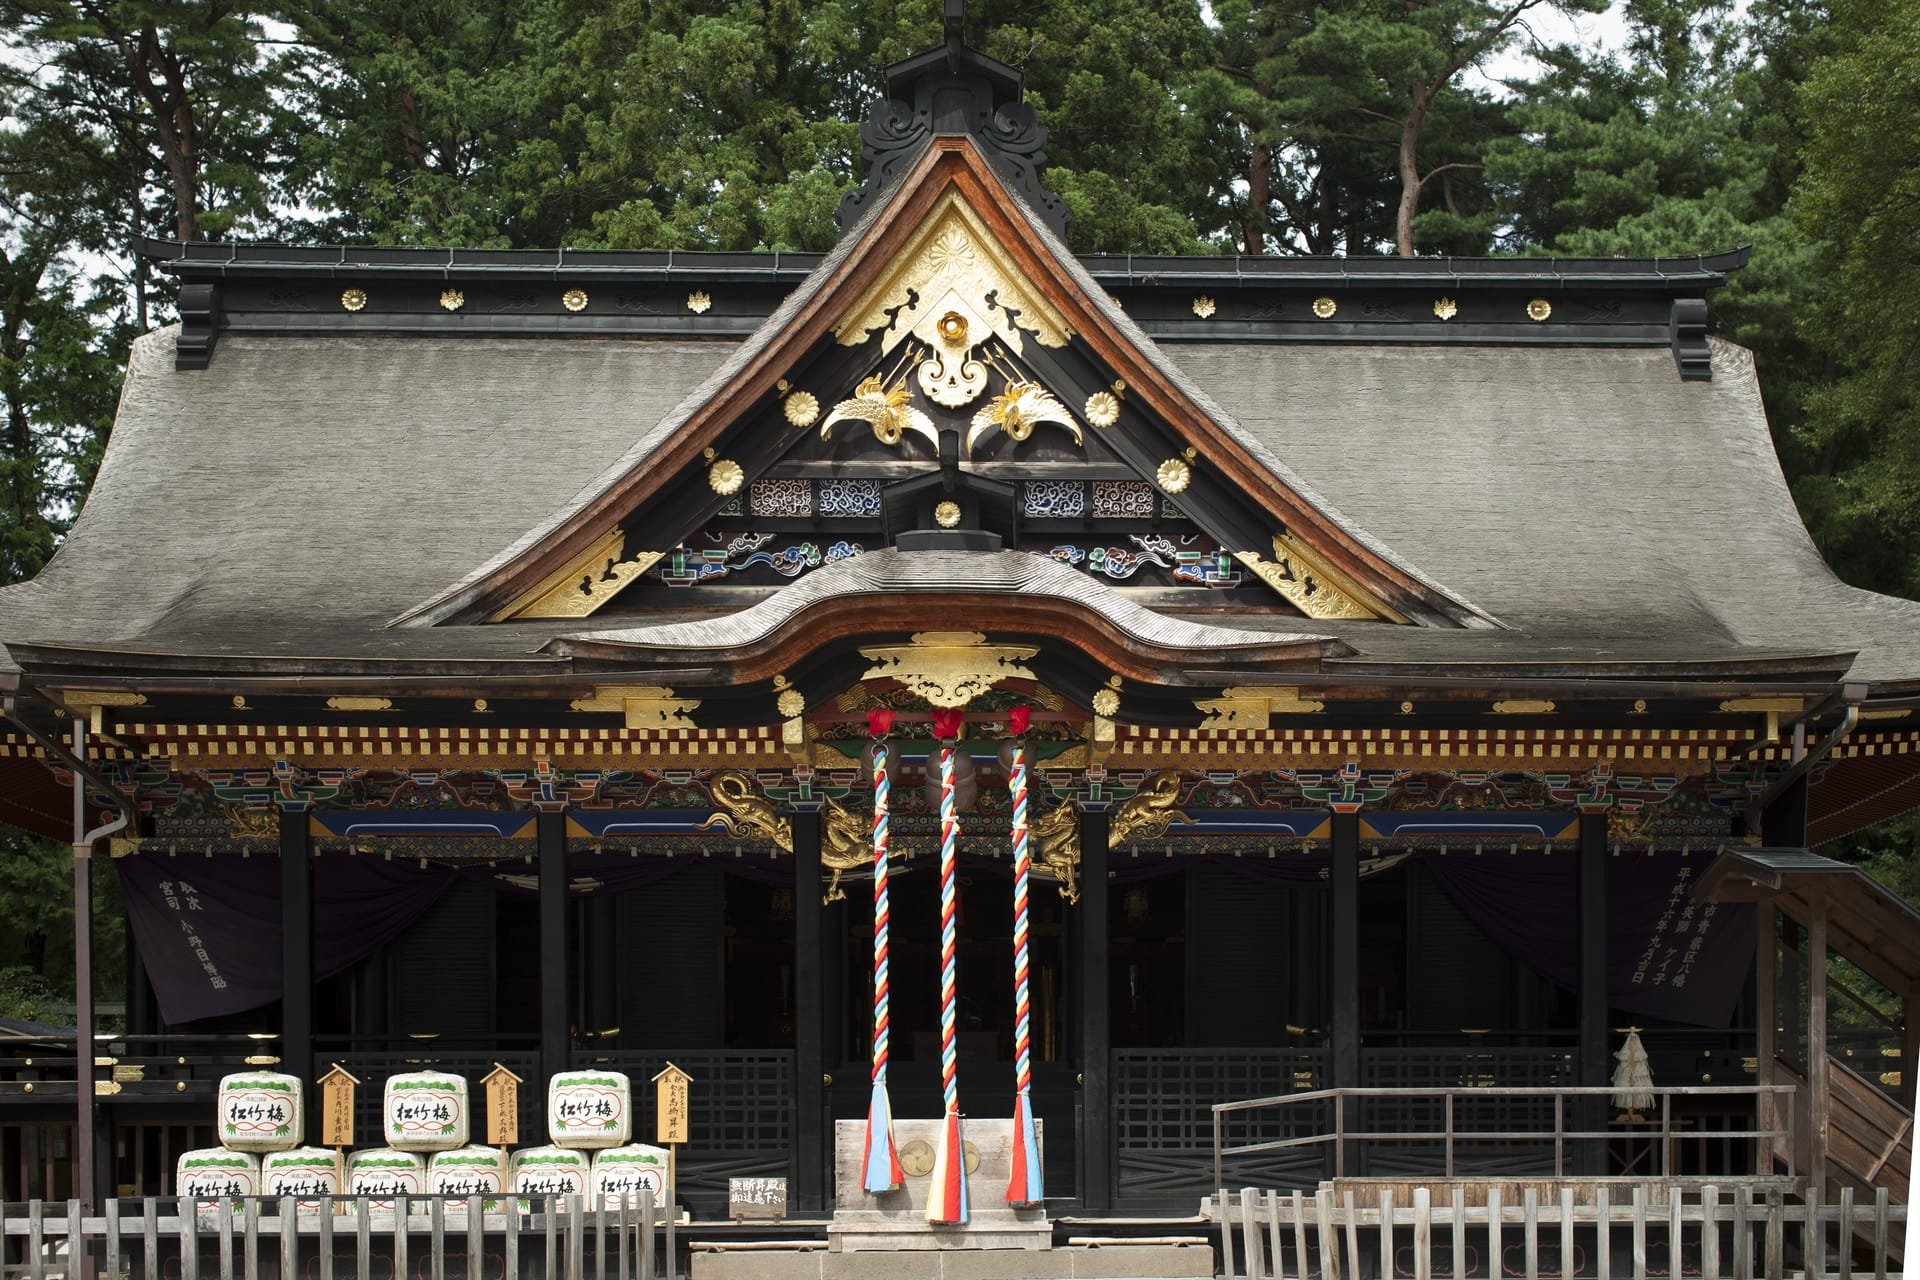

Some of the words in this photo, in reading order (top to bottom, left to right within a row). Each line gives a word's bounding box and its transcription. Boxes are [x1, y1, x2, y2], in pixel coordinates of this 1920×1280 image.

[159, 880, 181, 911] 宮司
[178, 880, 205, 911] 取次
[1652, 947, 1678, 986] ケイ子
[230, 1102, 286, 1122] 松竹梅
[397, 1102, 451, 1121] 松竹梅
[560, 1099, 613, 1118] 松竹梅
[188, 1179, 243, 1196] 松竹梅
[275, 1179, 331, 1196] 松竹梅
[356, 1179, 408, 1196] 松竹梅
[437, 1178, 493, 1195] 松竹梅
[522, 1178, 576, 1195] 松竹梅
[600, 1176, 654, 1194] 松竹梅
